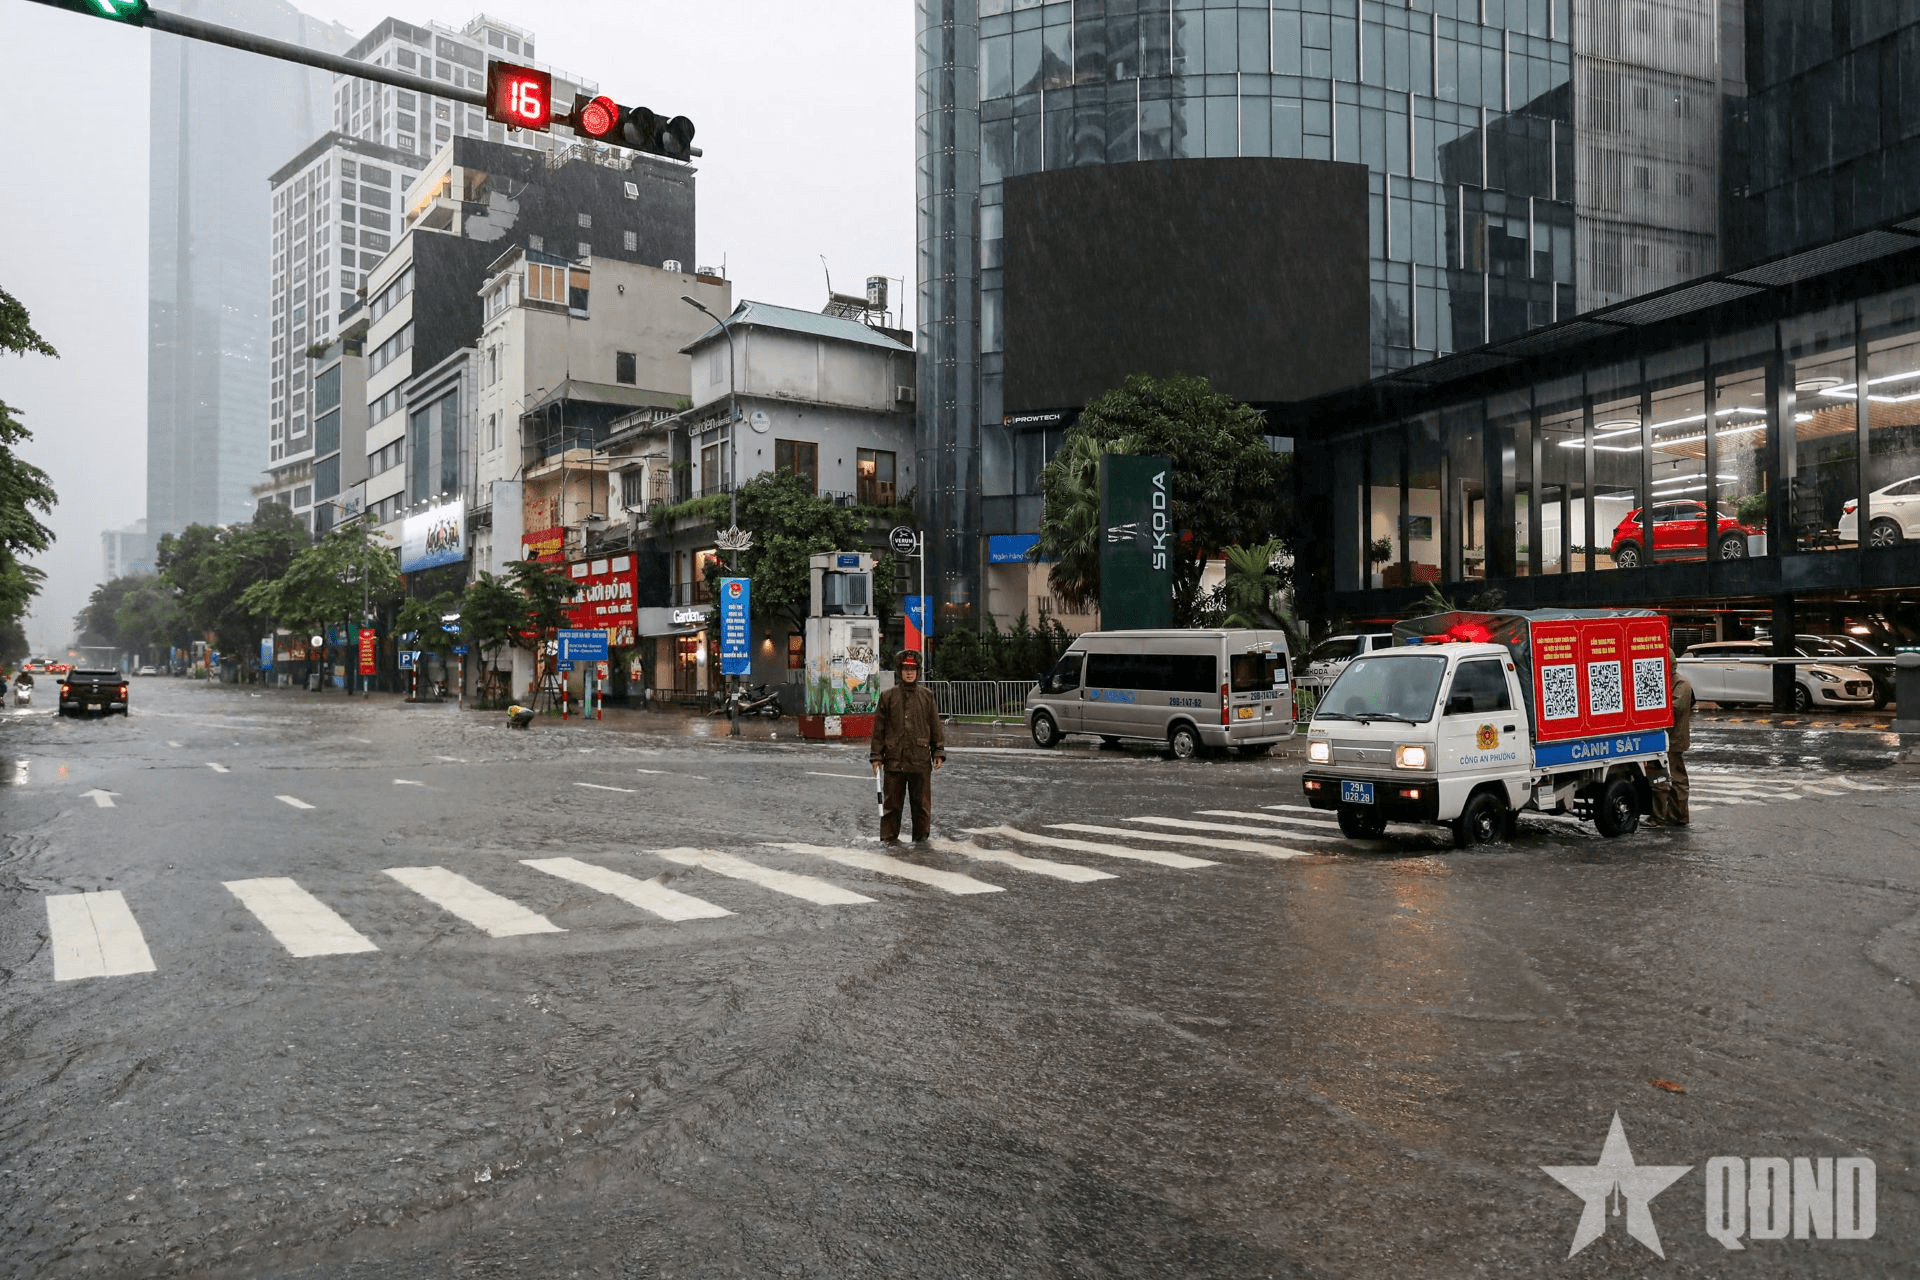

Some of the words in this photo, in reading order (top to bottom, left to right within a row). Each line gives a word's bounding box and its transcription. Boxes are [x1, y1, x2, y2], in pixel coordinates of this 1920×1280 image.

[510, 80, 541, 119] 16
[1015, 413, 1060, 423] PROWTECH
[688, 417, 716, 437] Garden
[619, 582, 632, 598] DA
[673, 608, 699, 623] Garden
[402, 655, 410, 664] P
[1616, 736, 1641, 753] SÁT
[1460, 755, 1478, 765] CÔNG
[1480, 755, 1488, 763] AN
[1350, 782, 1364, 793] 29A
